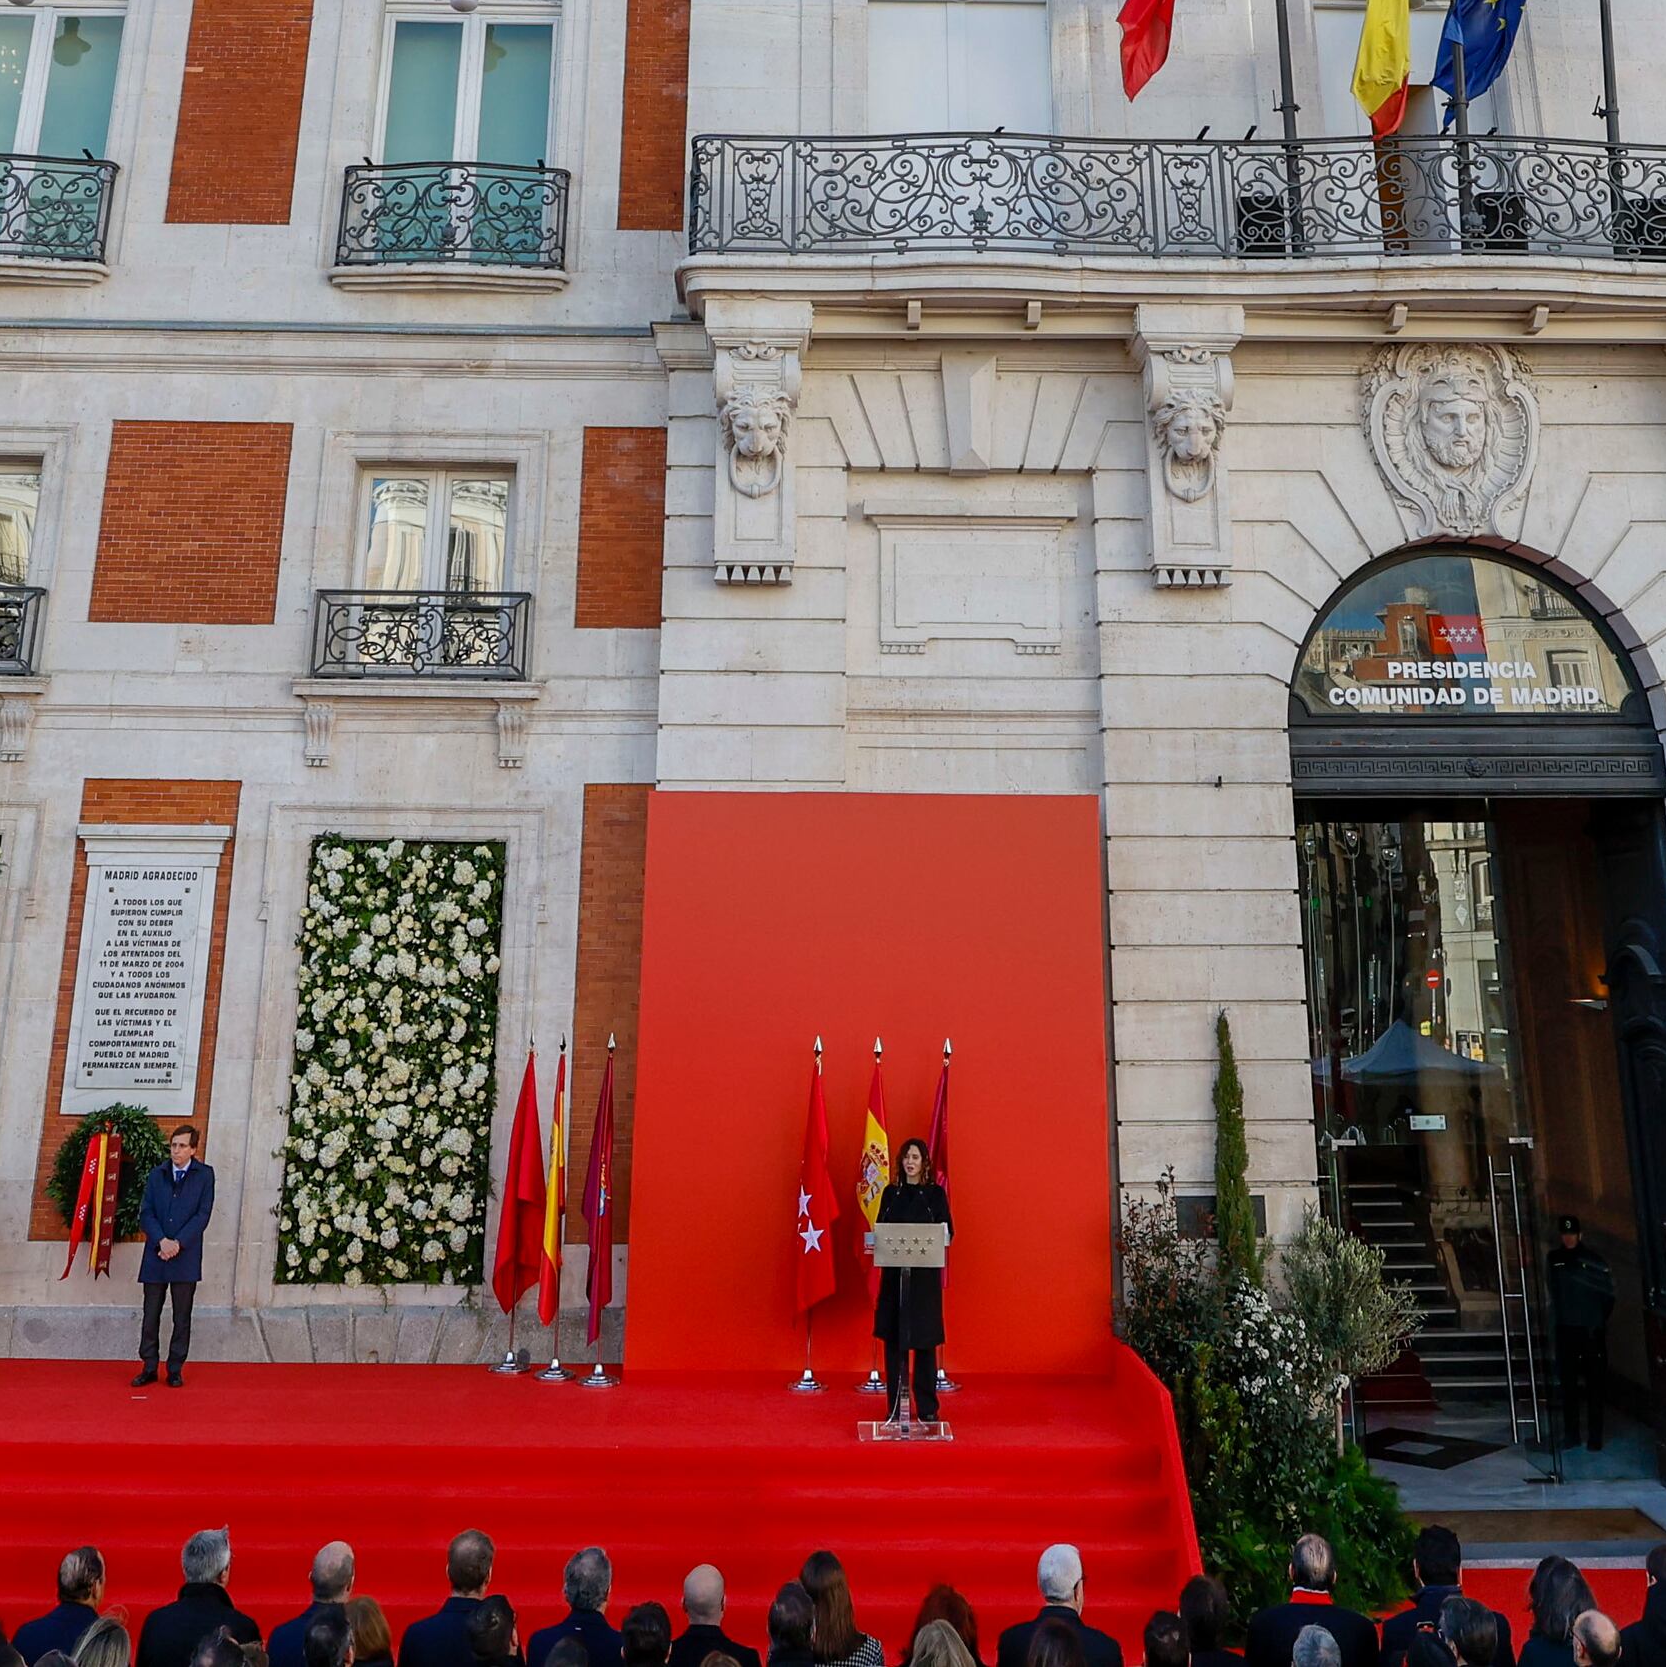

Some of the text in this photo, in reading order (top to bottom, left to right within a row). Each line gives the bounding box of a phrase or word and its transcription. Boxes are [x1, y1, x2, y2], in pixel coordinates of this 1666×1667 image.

[1388, 662, 1537, 679] PRESIDENCIA
[1329, 687, 1600, 705] COMUNIDAD DE MADRID
[105, 871, 197, 880] MADRID AGRADECIDO
[133, 939, 168, 947] VÍCTIMAS
[145, 980, 185, 988] ANÓNIMOS
[116, 1018, 152, 1026] VÍCTIMAS
